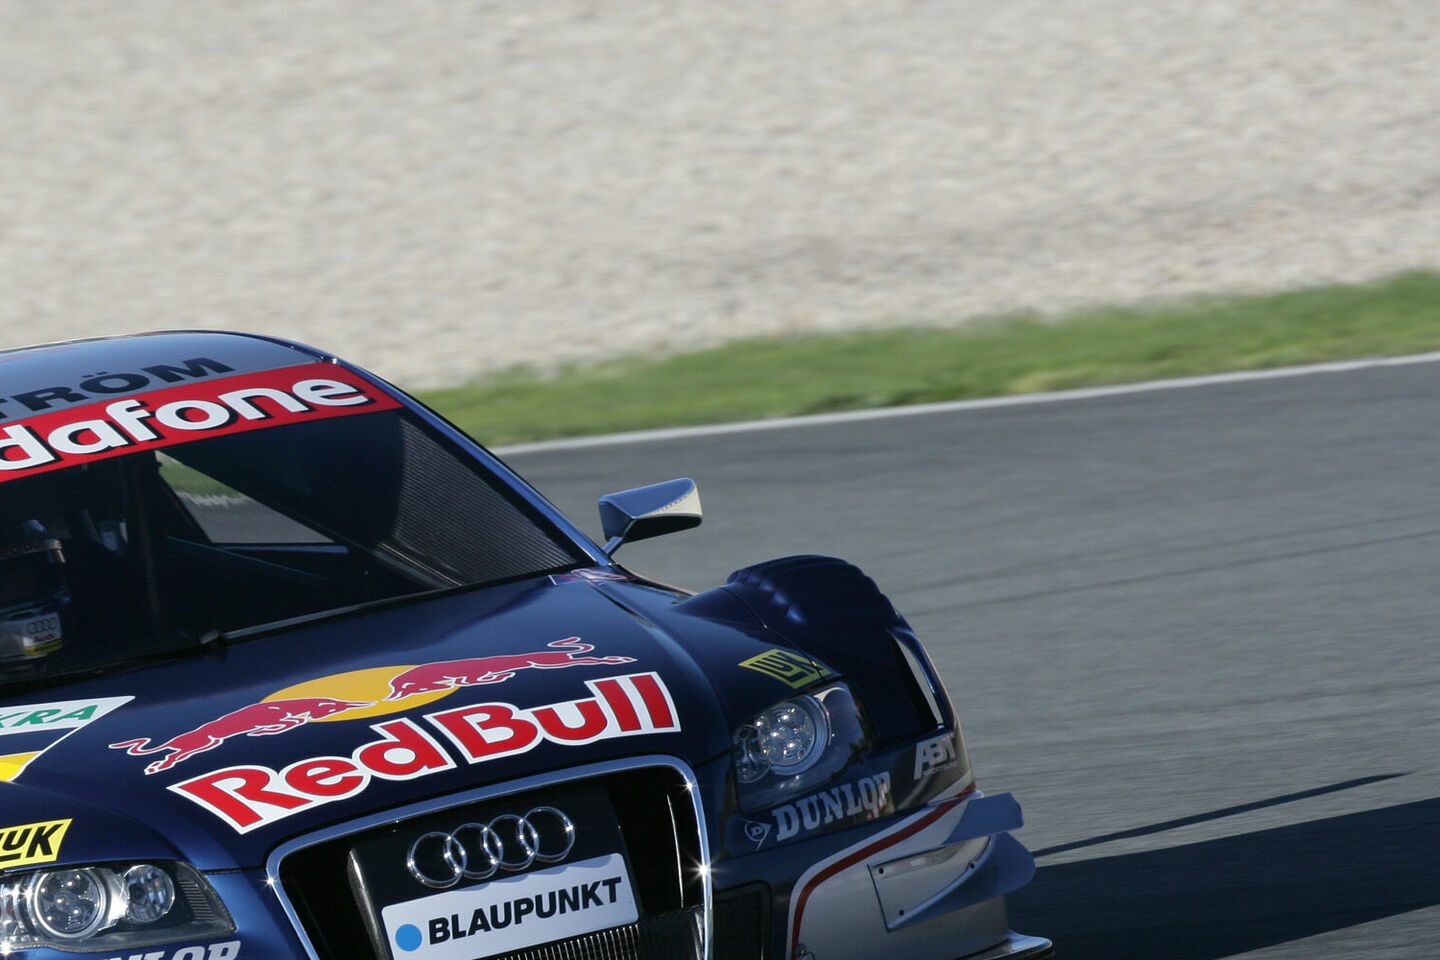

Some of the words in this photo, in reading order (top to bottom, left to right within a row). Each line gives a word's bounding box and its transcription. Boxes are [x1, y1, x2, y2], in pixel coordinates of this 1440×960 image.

[172, 720, 452, 831] Red
[428, 674, 678, 761] Bull
[772, 771, 891, 841] DUNLOP
[429, 877, 622, 945] BLAUPUNKT
